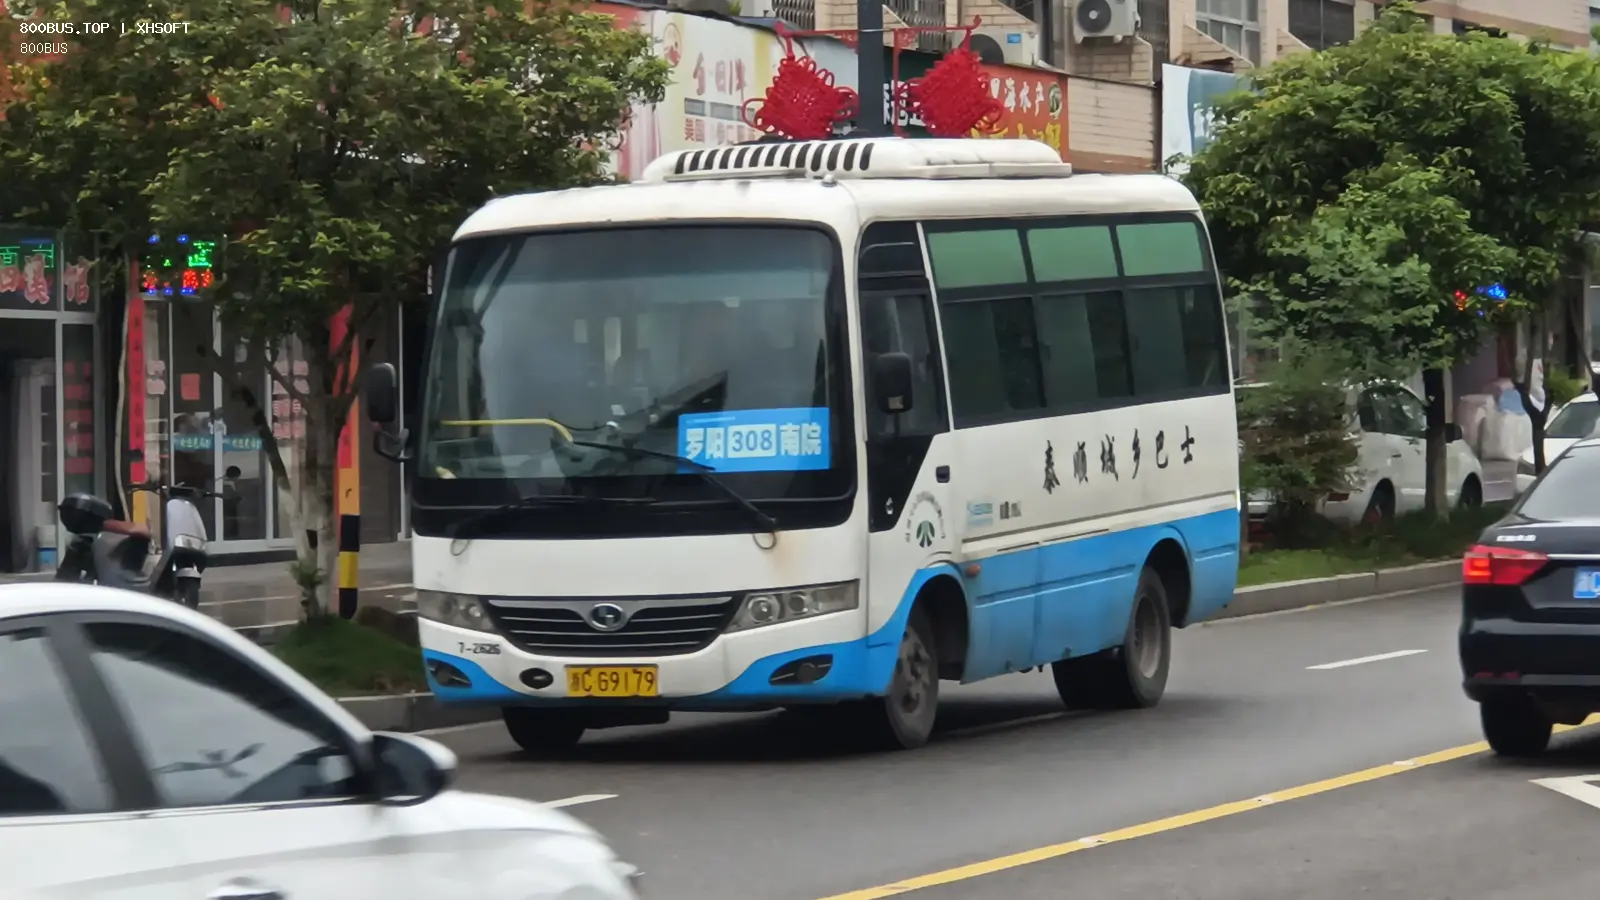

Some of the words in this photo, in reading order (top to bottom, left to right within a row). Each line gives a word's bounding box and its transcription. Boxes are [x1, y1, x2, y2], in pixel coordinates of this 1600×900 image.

[685, 427, 725, 460] 罗阳
[731, 428, 773, 452] 308
[779, 422, 822, 456] 南院
[1042, 425, 1195, 495] 泰顺城乡巴士
